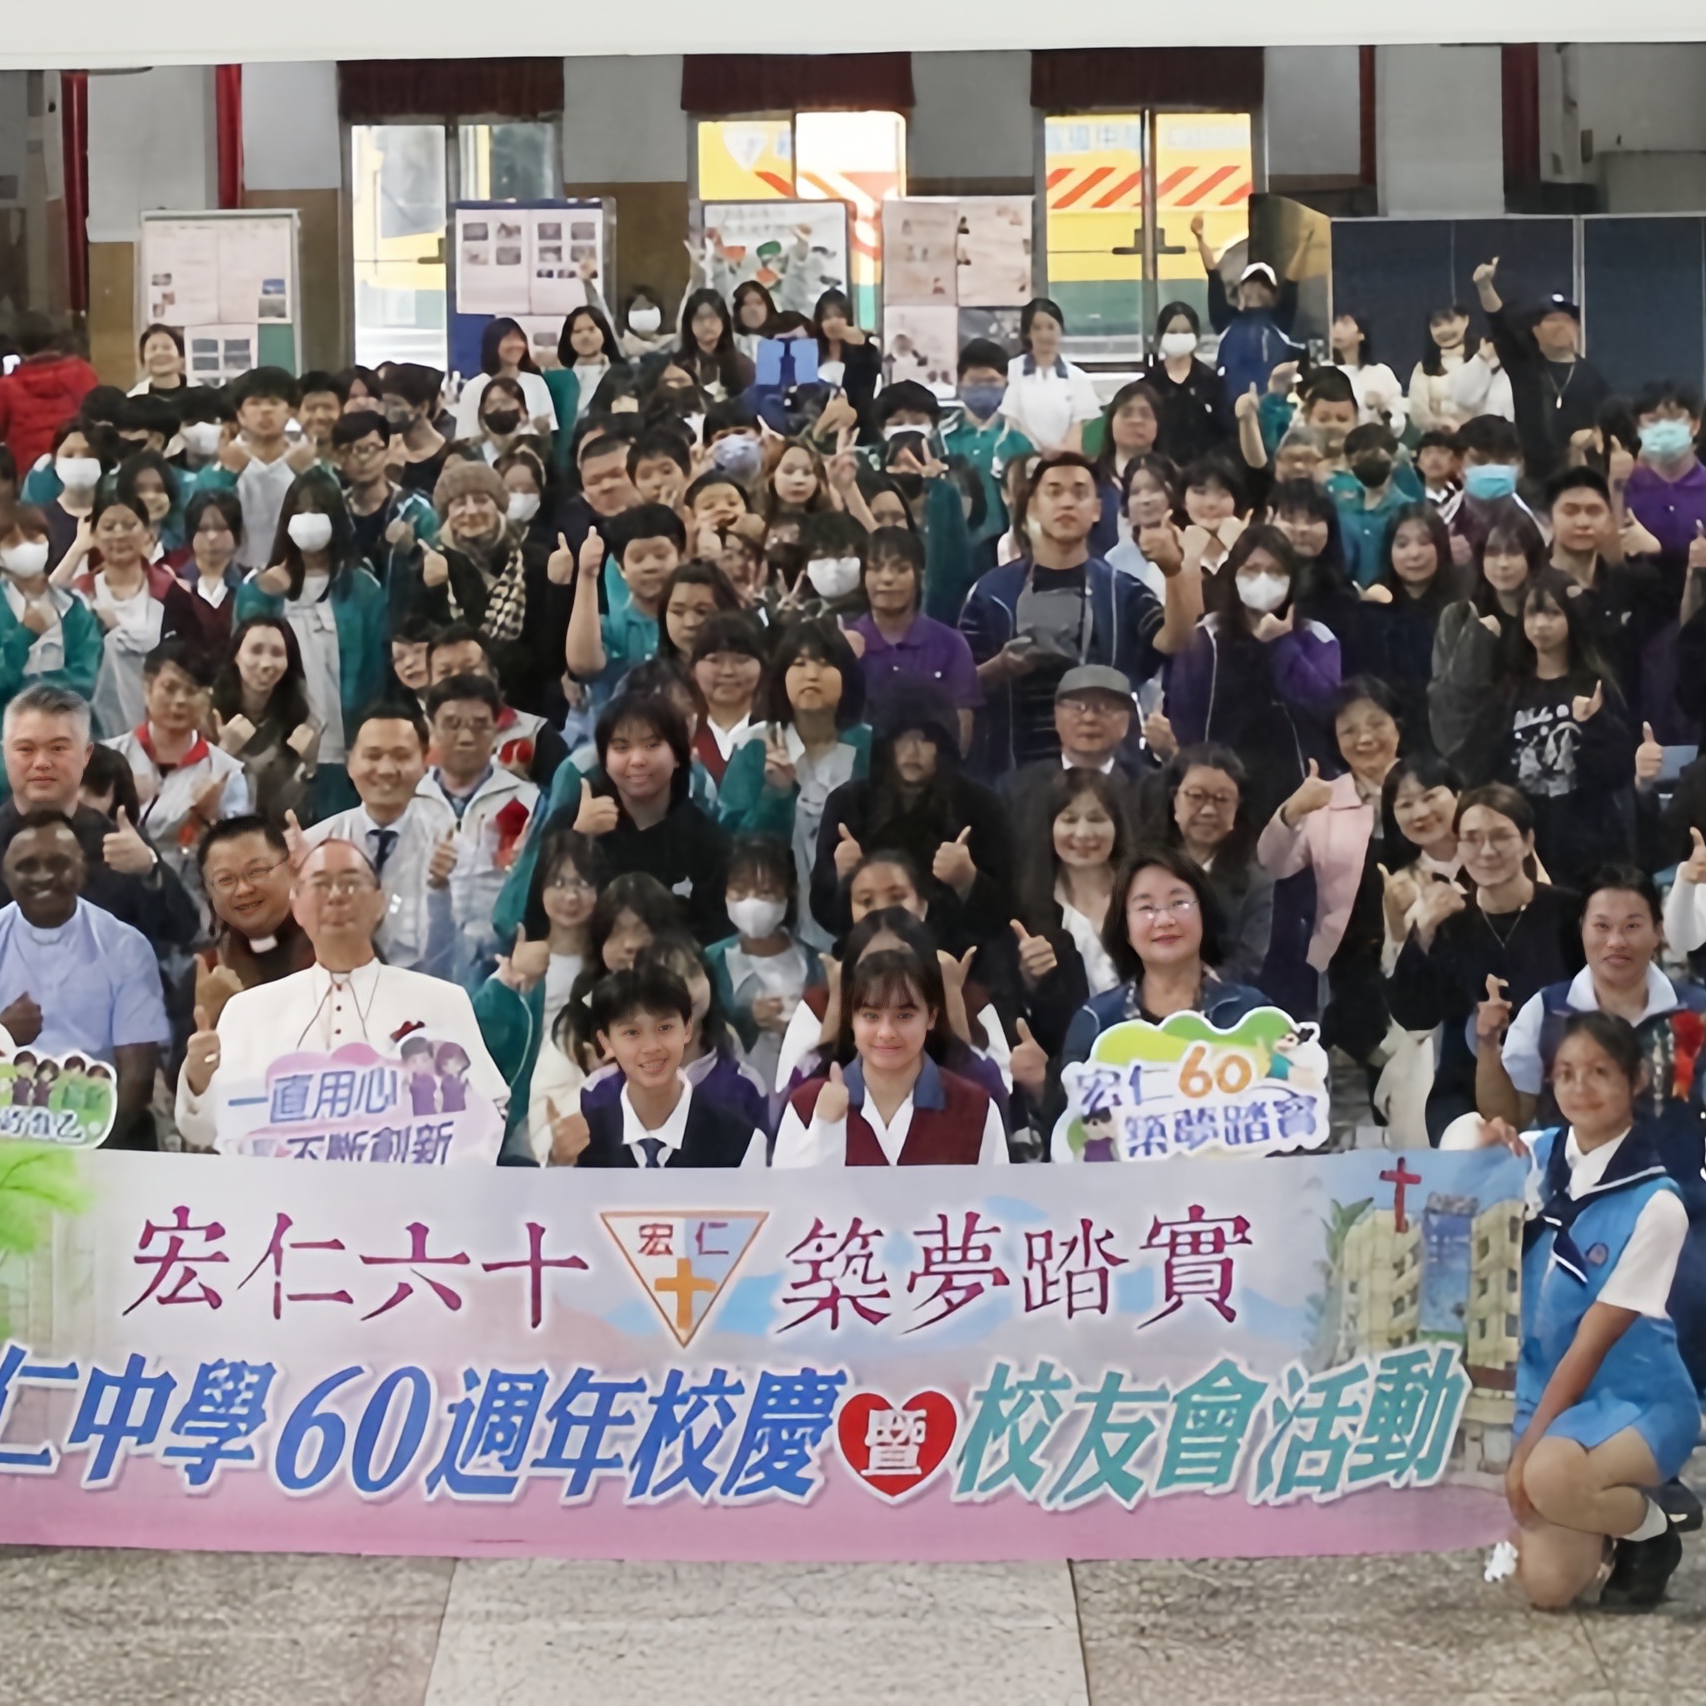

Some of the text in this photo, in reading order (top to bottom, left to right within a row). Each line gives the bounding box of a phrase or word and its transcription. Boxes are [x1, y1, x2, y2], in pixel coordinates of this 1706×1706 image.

[228, 1066, 398, 1124] 一直用心
[122, 1204, 1255, 1335] 宏仁六十 築夢踏實
[637, 1221, 730, 1256] 宏仁
[860, 1404, 930, 1478] 暨
[951, 1344, 1467, 1504] 校友會活動
